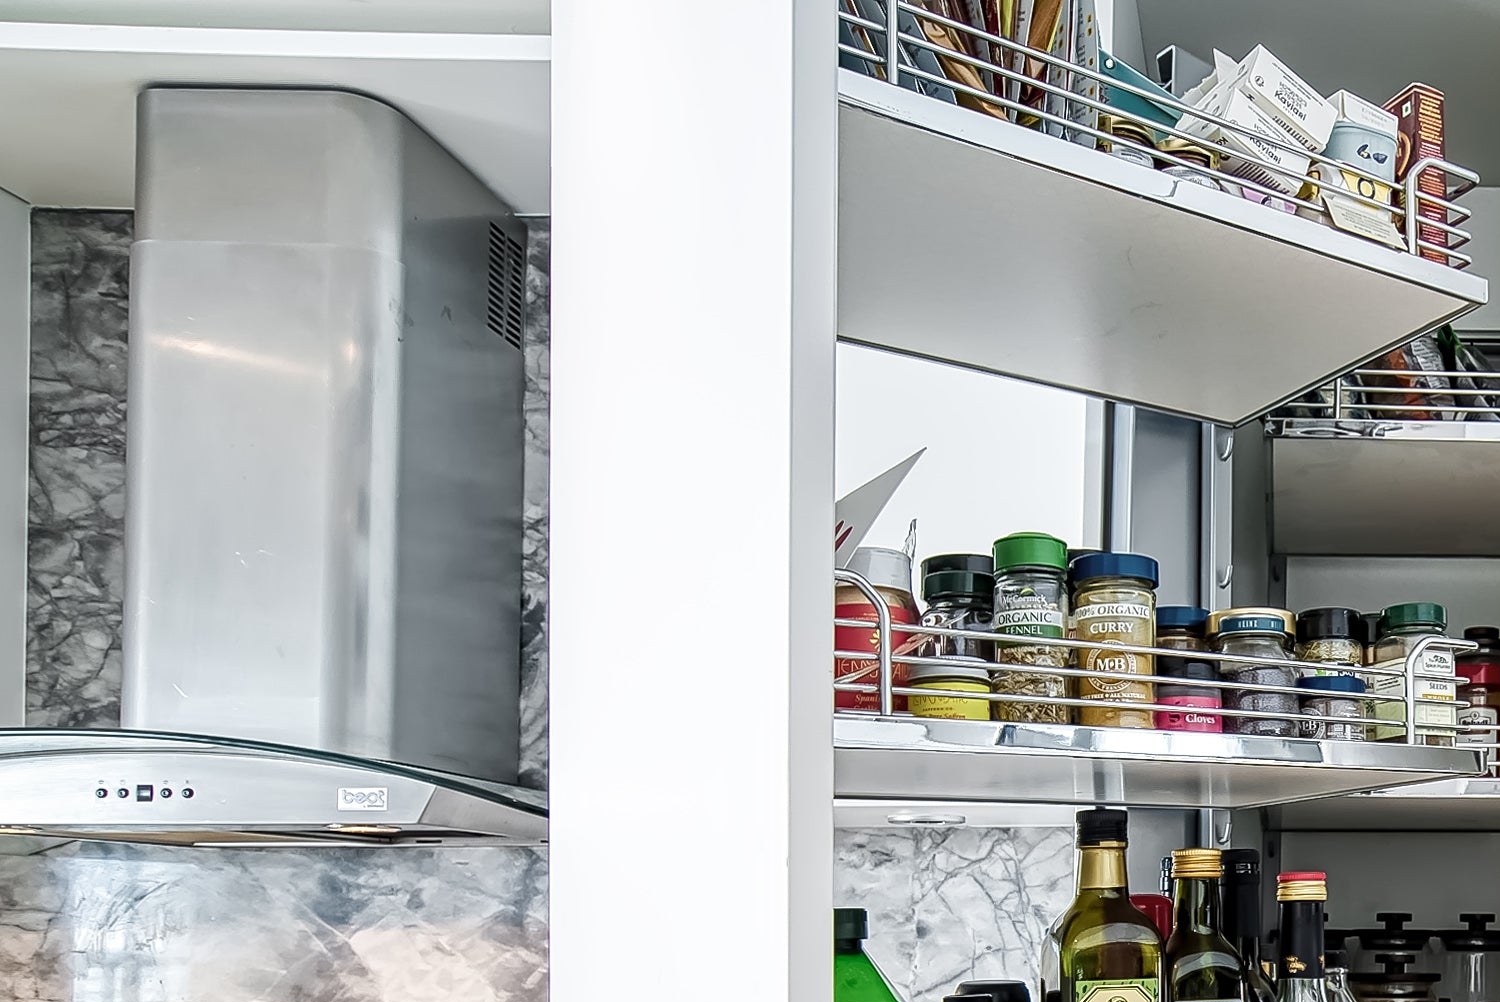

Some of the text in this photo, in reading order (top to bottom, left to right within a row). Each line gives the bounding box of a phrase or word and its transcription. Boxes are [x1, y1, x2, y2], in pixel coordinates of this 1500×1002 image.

[1274, 90, 1307, 120] Kaviari
[1097, 604, 1149, 617] ORGANIC
[998, 611, 1052, 625] ORGANIC
[1005, 625, 1043, 635] FENNEL
[1090, 622, 1134, 634] CURRY
[1185, 713, 1215, 724] Cloves
